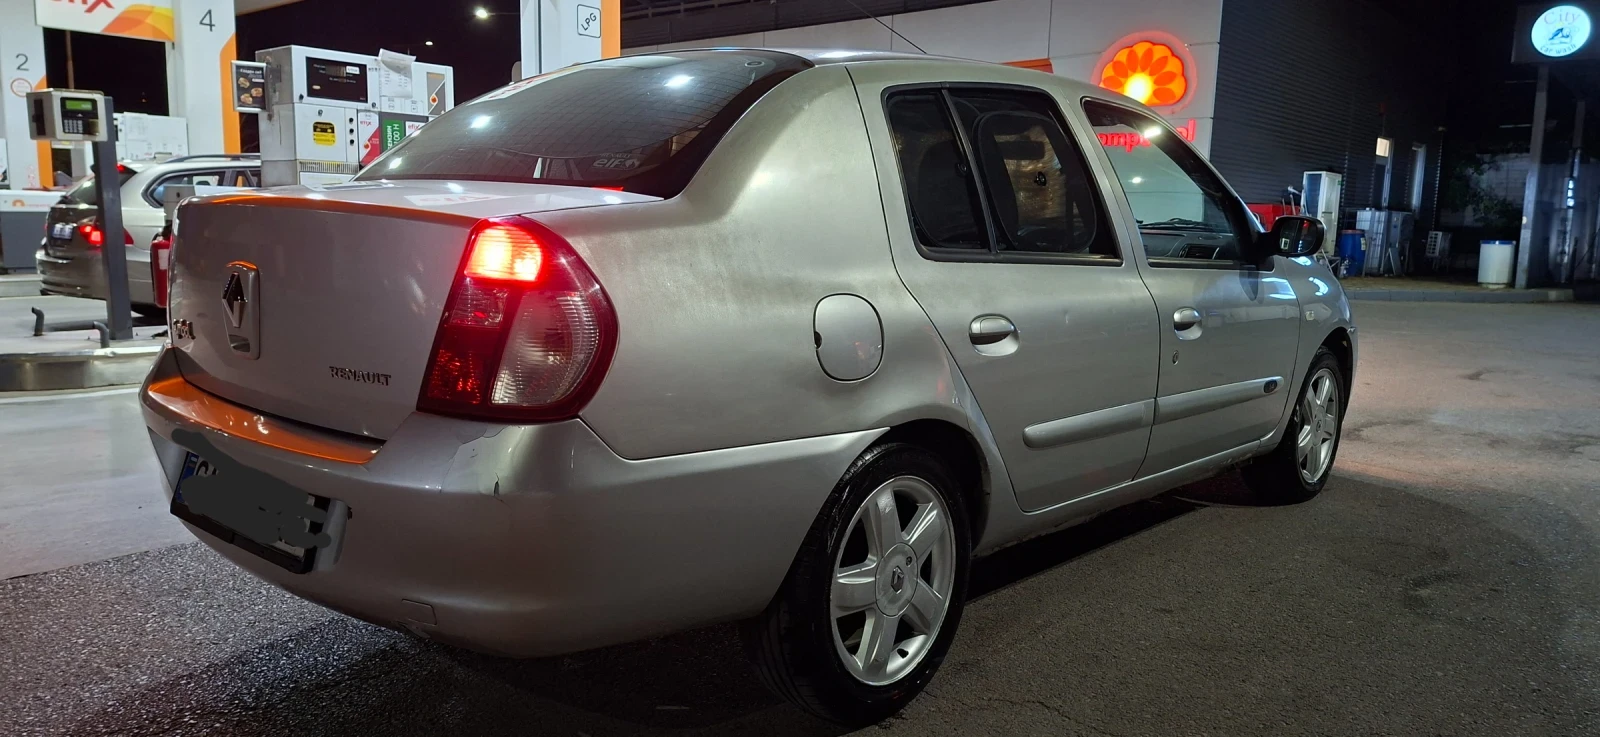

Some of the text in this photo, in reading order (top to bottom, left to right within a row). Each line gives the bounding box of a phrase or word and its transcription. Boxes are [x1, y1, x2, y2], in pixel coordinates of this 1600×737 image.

[199, 9, 216, 32] 4
[581, 12, 597, 31] LPG
[15, 53, 30, 71] 2
[329, 366, 391, 386] RENAULT
